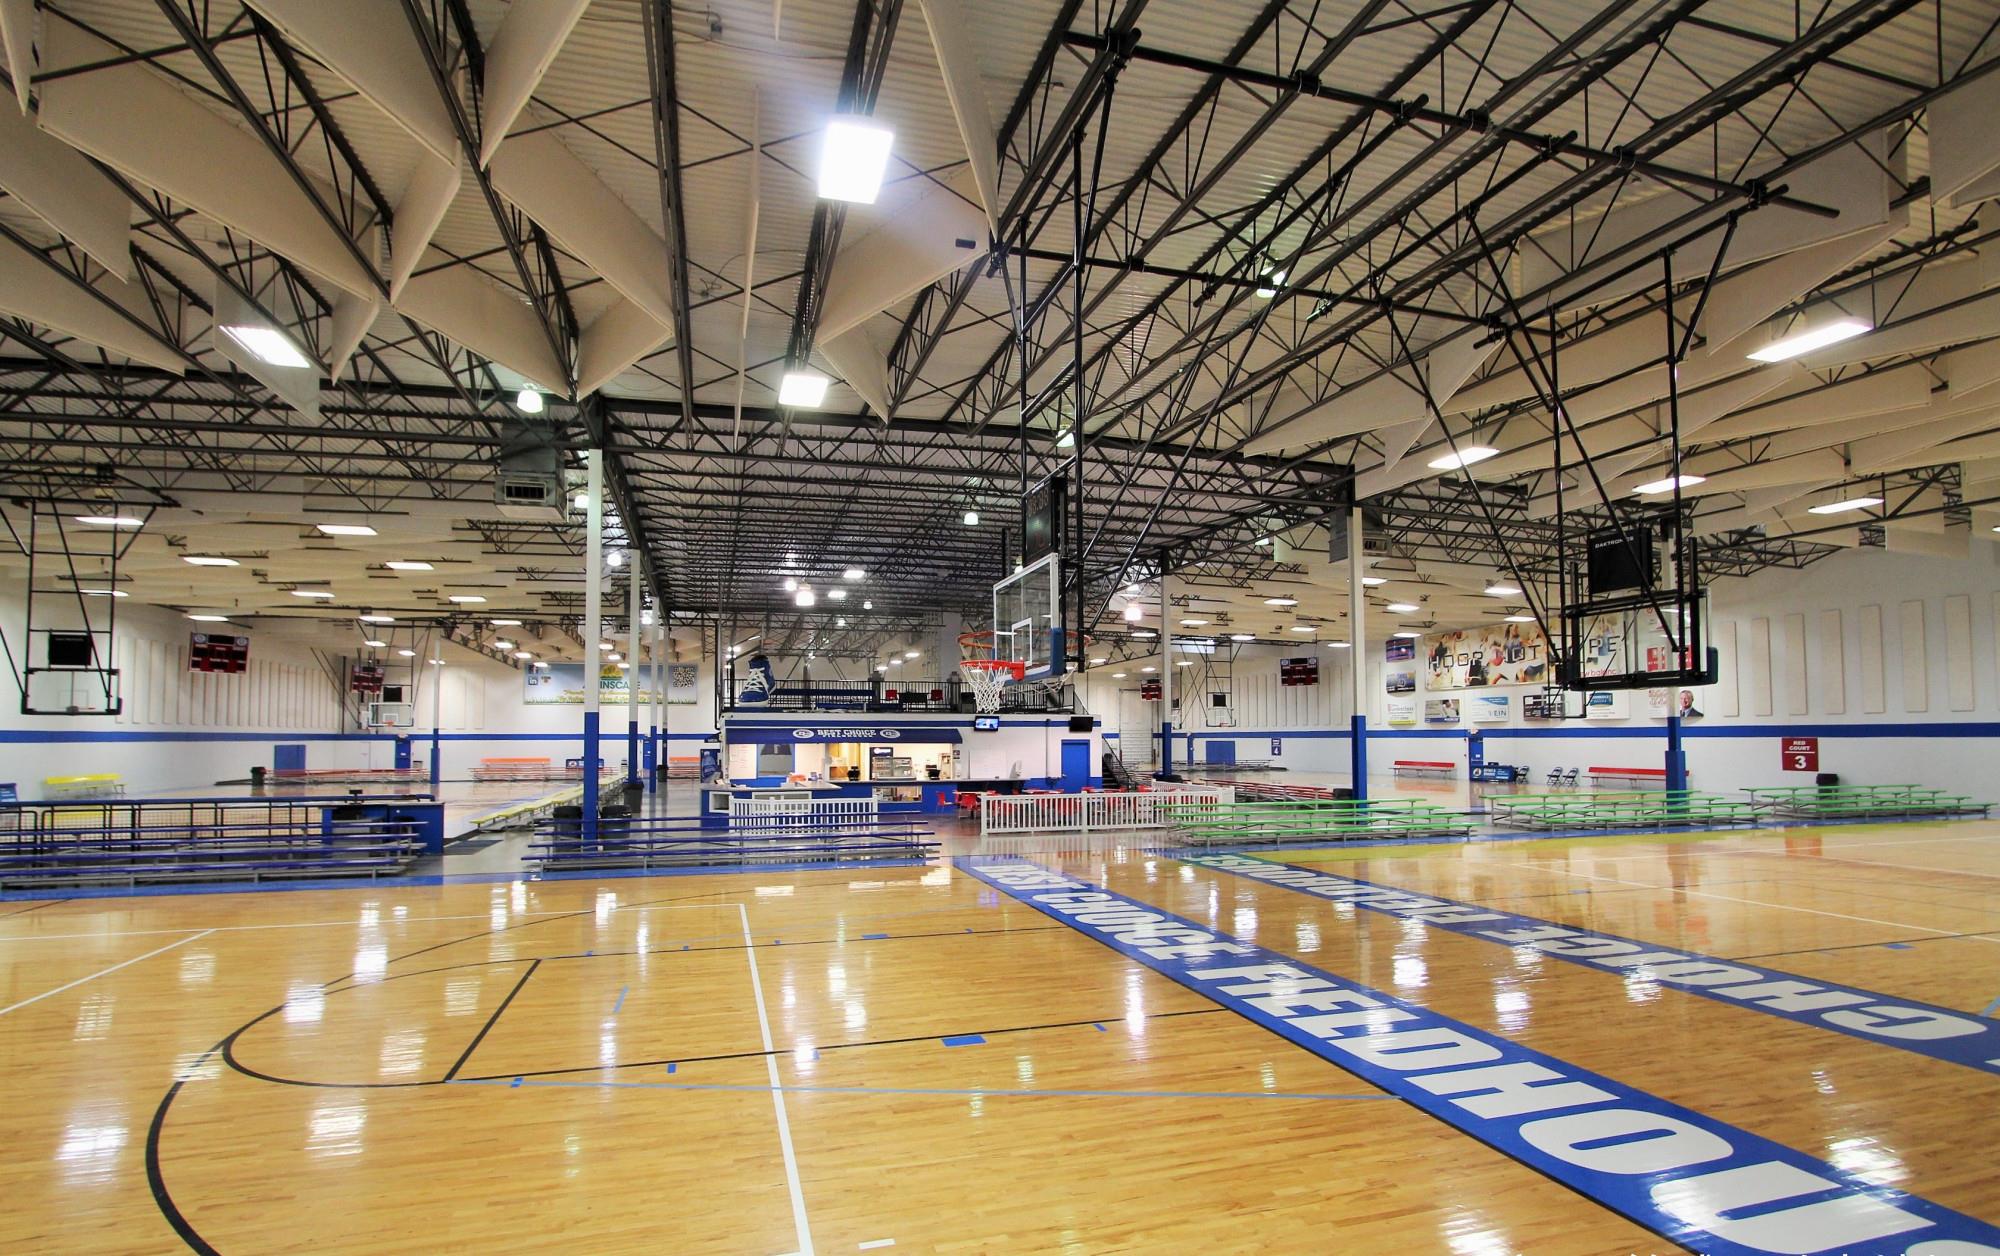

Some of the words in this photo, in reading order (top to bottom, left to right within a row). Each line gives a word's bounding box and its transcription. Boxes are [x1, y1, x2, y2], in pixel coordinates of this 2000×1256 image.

[1594, 535, 1634, 548] DAKTRONCS
[1428, 651, 1483, 670] HOOP
[1794, 755, 1807, 769] 3
[1476, 923, 1988, 1040] CHOICE
[970, 864, 1088, 891] BEST
[1032, 891, 1259, 963] CHOICE
[1186, 961, 2000, 1256] FIELDHOU
